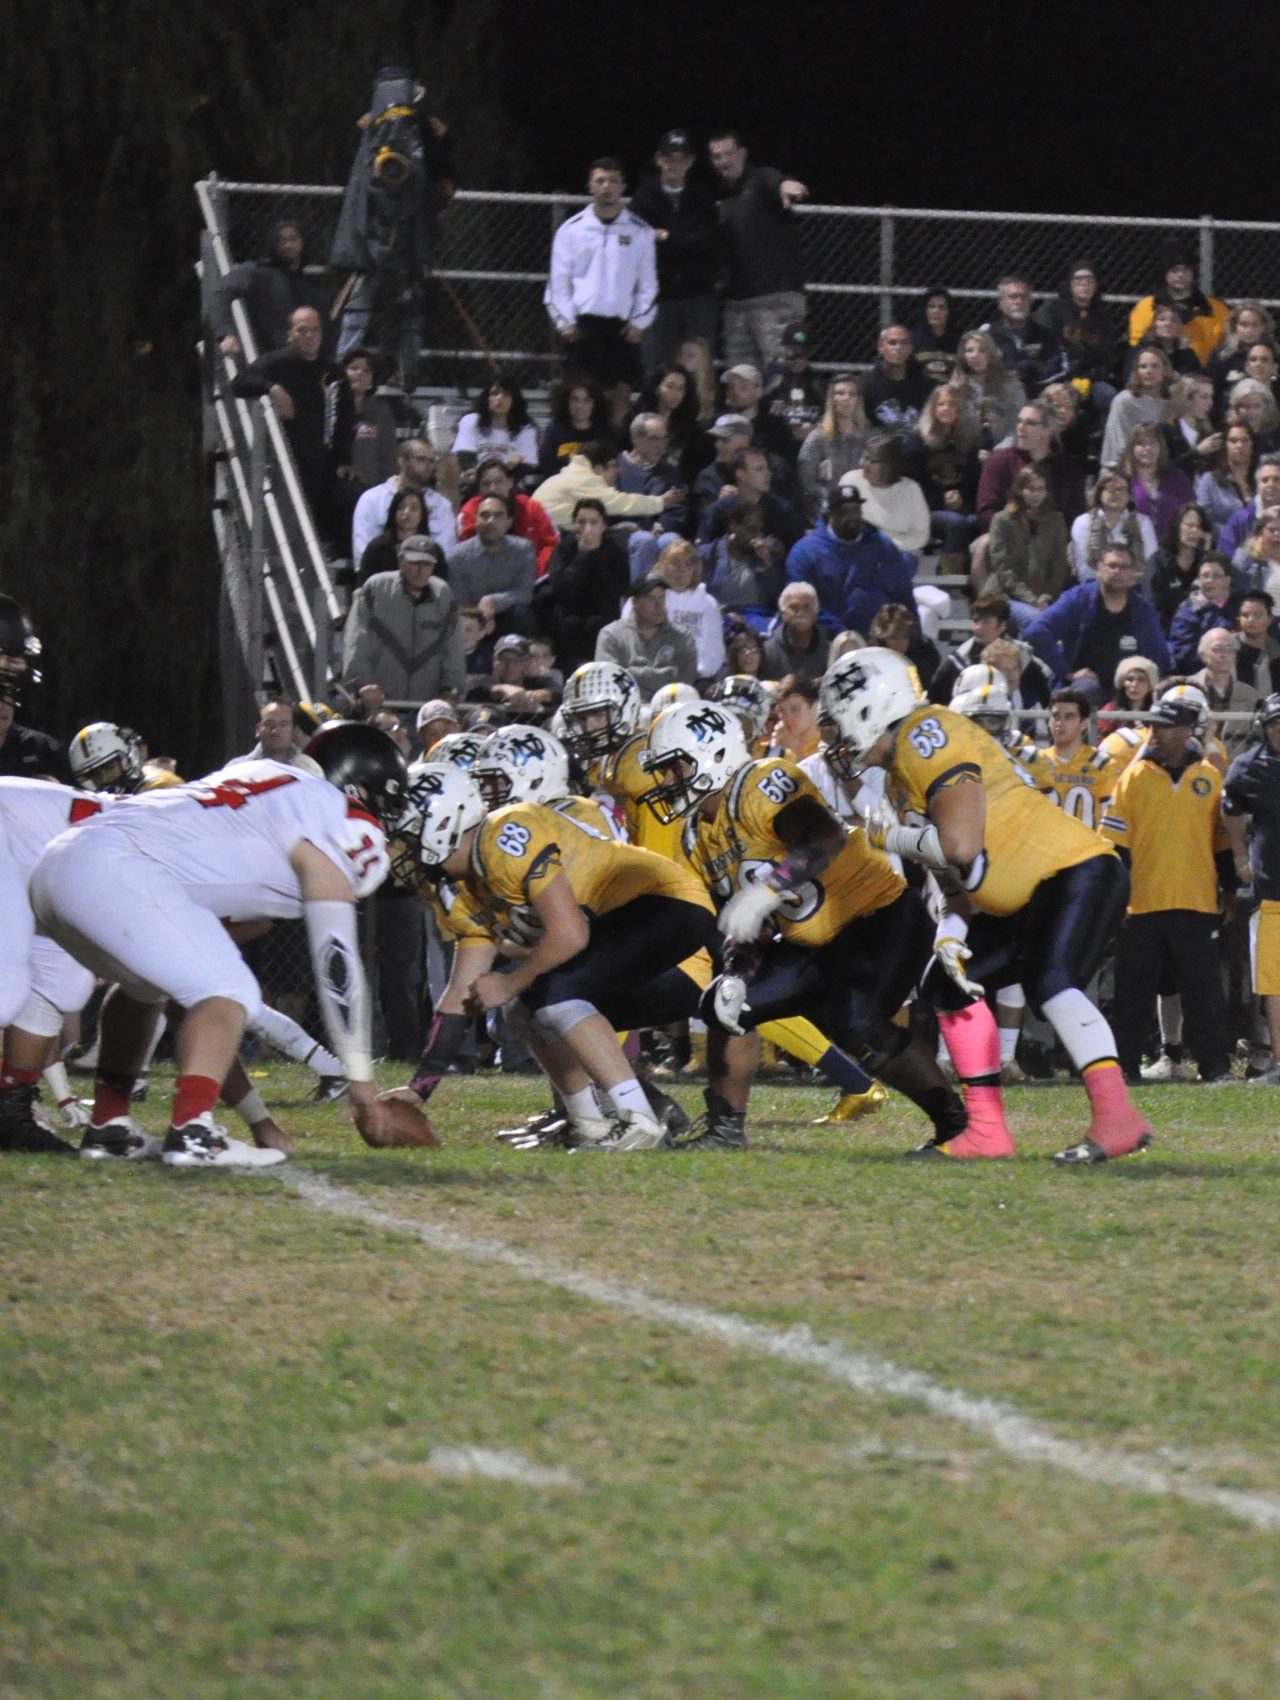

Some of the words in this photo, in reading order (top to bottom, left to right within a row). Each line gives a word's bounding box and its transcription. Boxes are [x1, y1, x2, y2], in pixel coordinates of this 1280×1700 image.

[907, 717, 948, 759] 53
[756, 768, 799, 804] 56
[496, 822, 531, 857] 68
